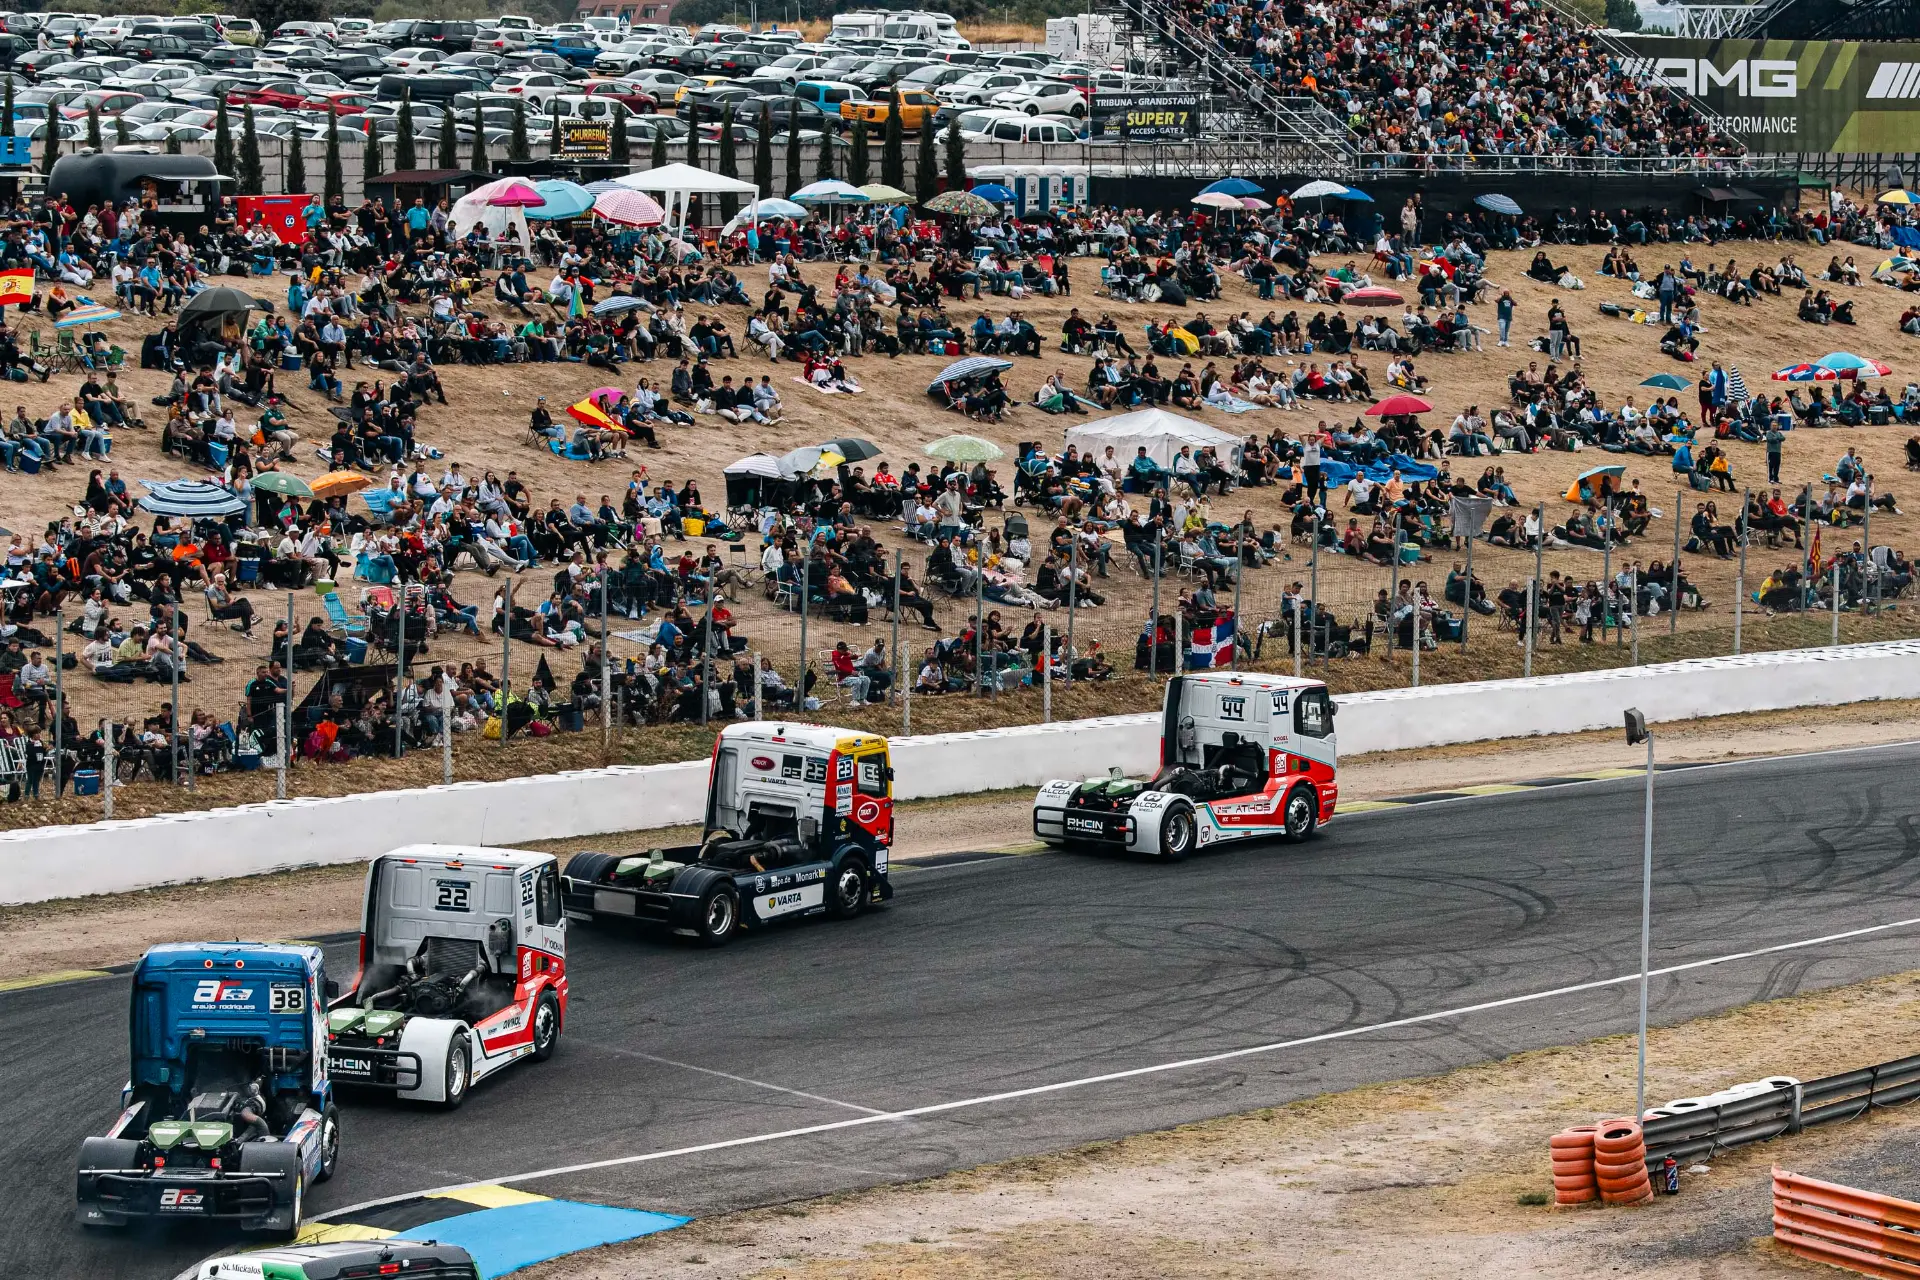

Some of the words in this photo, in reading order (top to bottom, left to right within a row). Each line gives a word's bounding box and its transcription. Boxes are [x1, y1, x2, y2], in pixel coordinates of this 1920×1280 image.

[1651, 58, 1797, 97] AMG
[1096, 99, 1132, 107] TRIBUNA
[1138, 97, 1196, 106] GRANDSTAND
[1126, 112, 1175, 126] SUPER
[1178, 112, 1188, 125] 7
[1222, 702, 1244, 717] 44
[1273, 696, 1289, 711] 44
[806, 763, 826, 780] 23
[838, 761, 852, 777] 23
[768, 777, 787, 785] VARTA
[1236, 803, 1270, 813] ATHOS
[1067, 818, 1103, 830] RHEIN
[796, 871, 819, 882] Monark
[438, 888, 468, 907] 22
[521, 881, 533, 901] 22
[777, 893, 802, 906] VARTA
[273, 990, 302, 1008] 38
